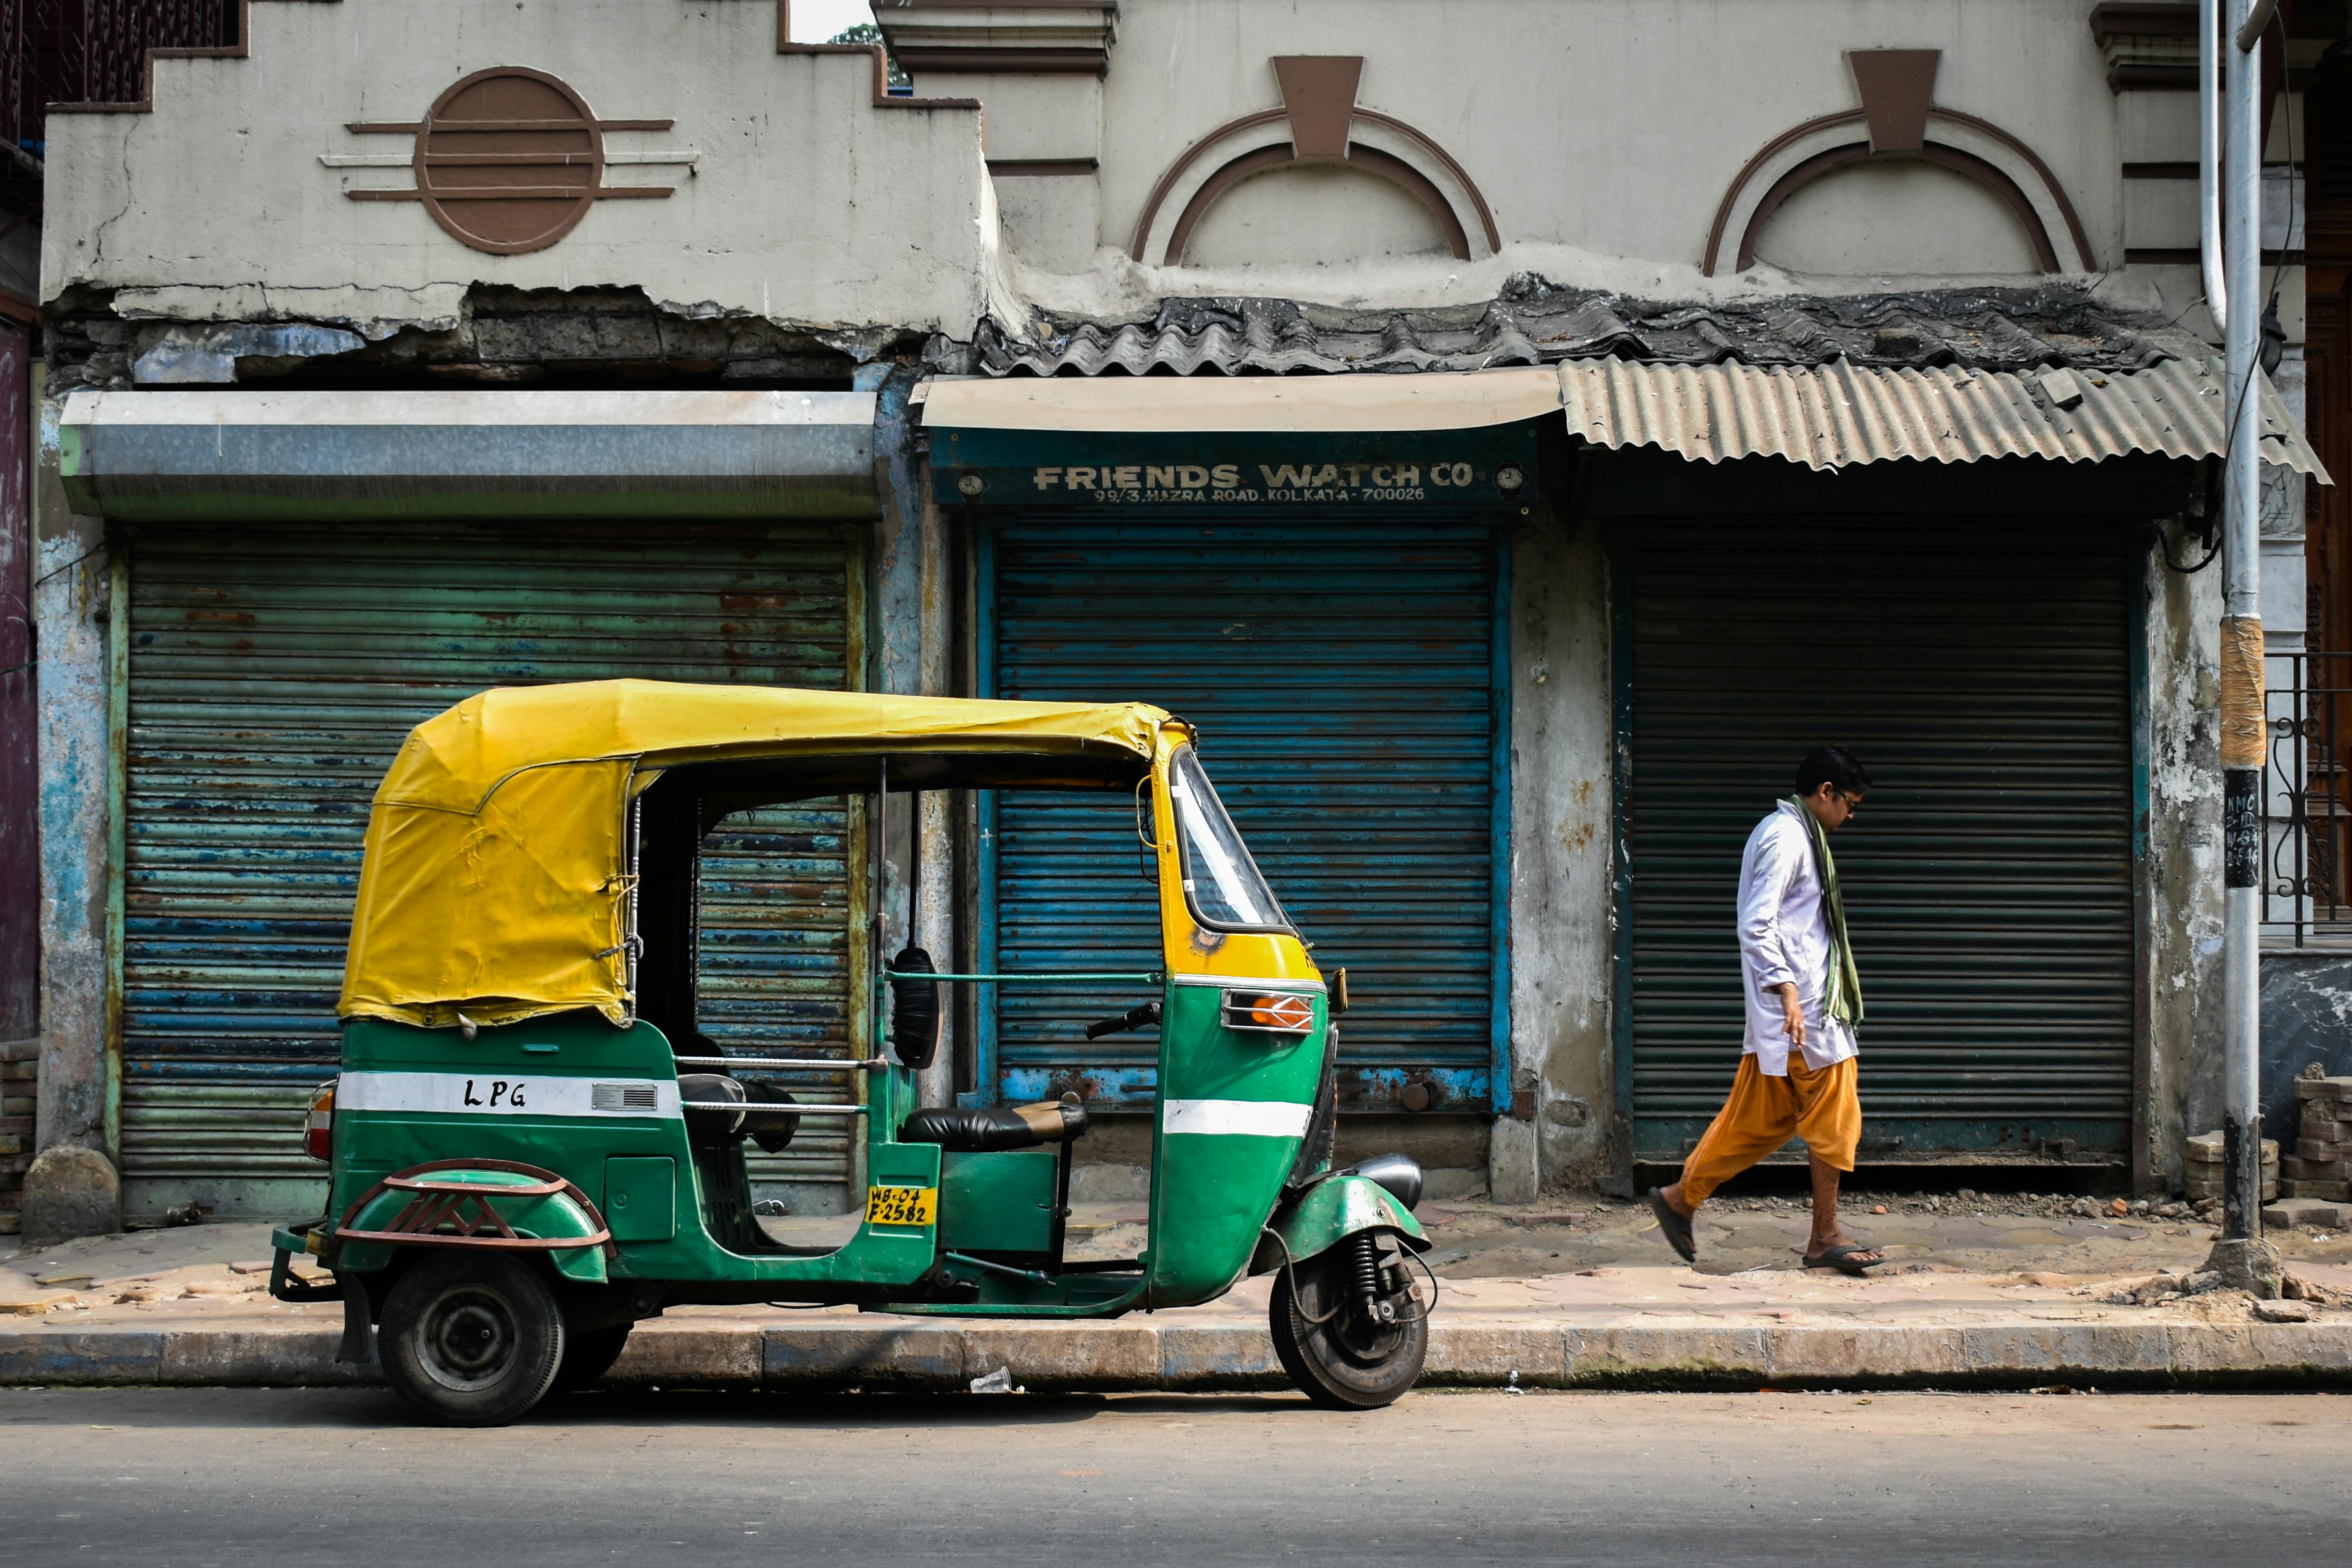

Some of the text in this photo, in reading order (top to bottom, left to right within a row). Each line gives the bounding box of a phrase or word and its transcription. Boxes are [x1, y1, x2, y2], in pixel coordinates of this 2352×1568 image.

[1033, 462, 1473, 490] FRIENDS WATCH CO
[2227, 793, 2255, 813] KMC
[464, 1079, 527, 1108] LPG
